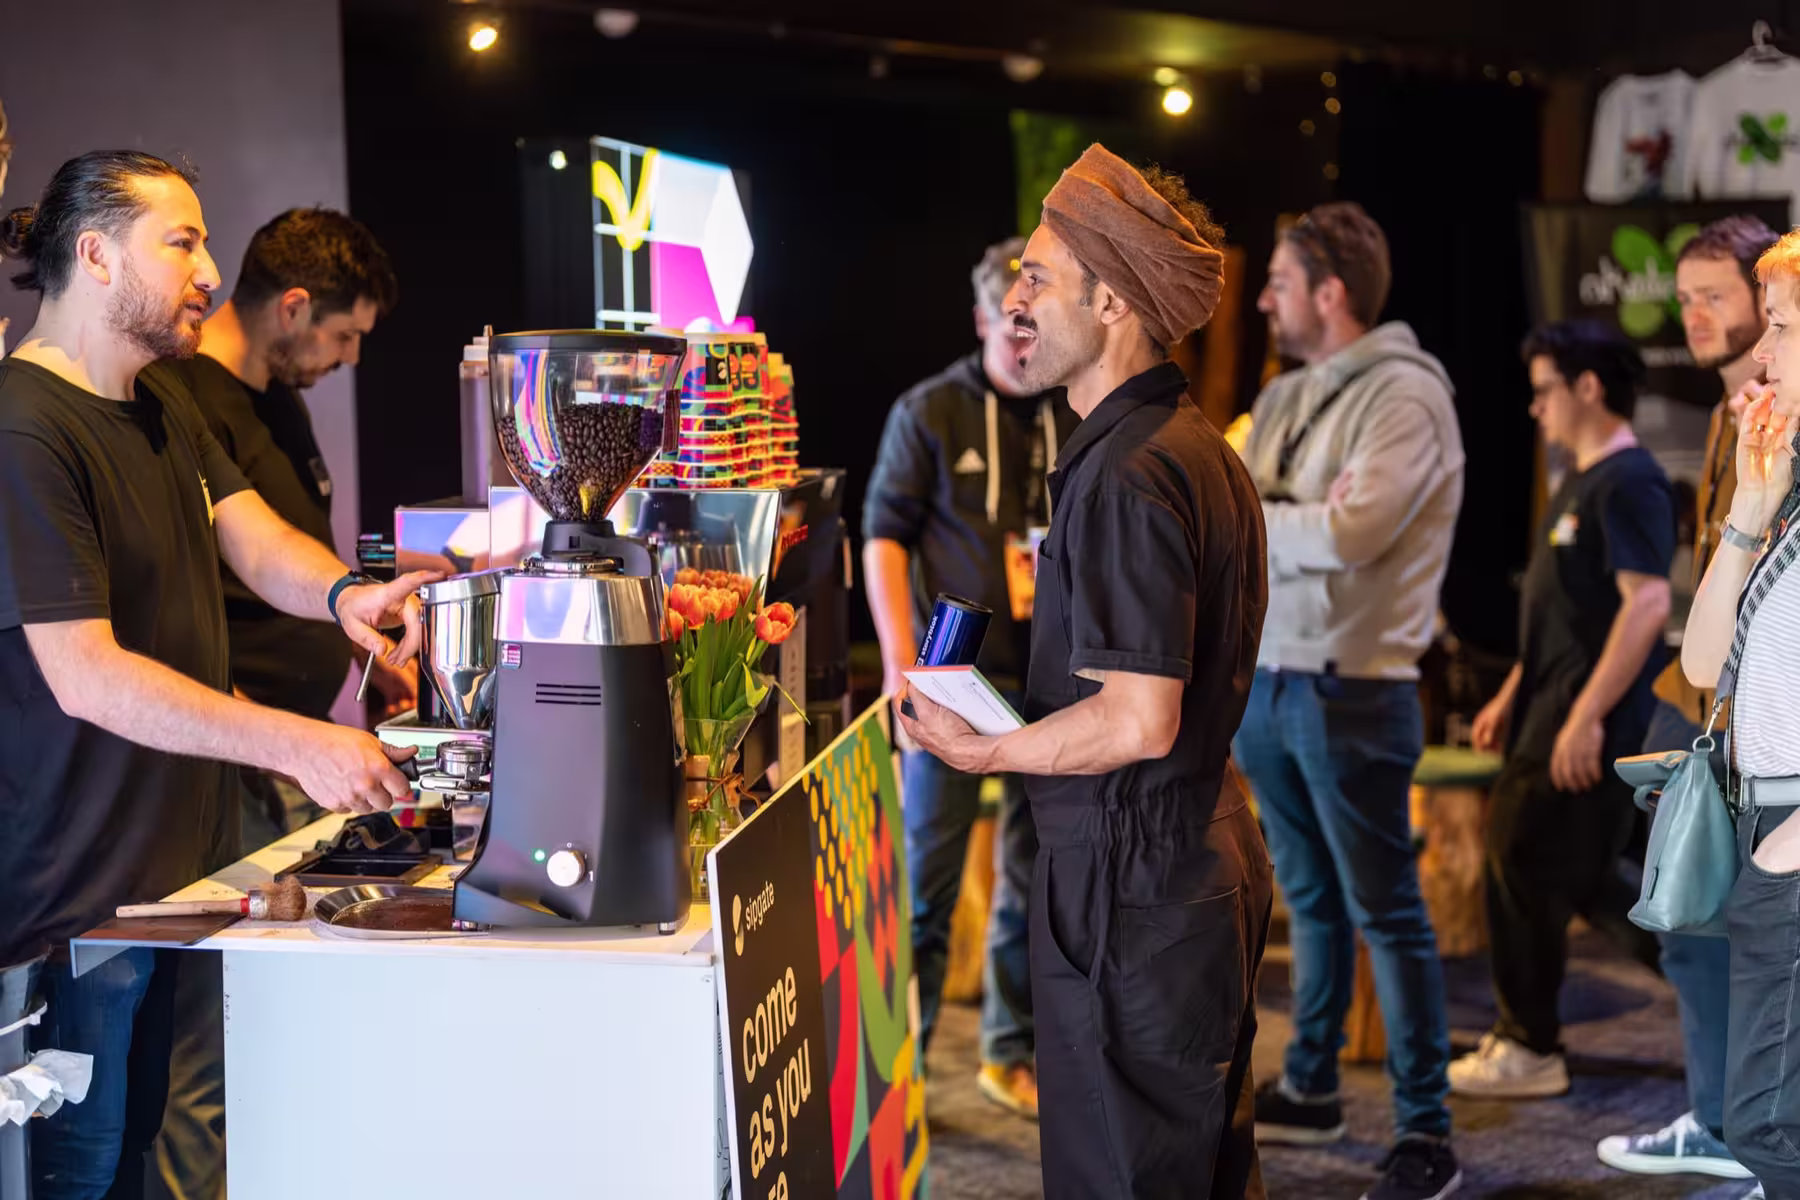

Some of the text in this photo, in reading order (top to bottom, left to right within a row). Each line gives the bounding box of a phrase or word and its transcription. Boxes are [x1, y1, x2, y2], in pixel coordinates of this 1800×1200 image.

[921, 615, 939, 656] storyblok
[745, 880, 775, 932] sipgate
[743, 966, 797, 1084] come
[750, 1093, 776, 1179] as
[776, 1038, 812, 1157] you
